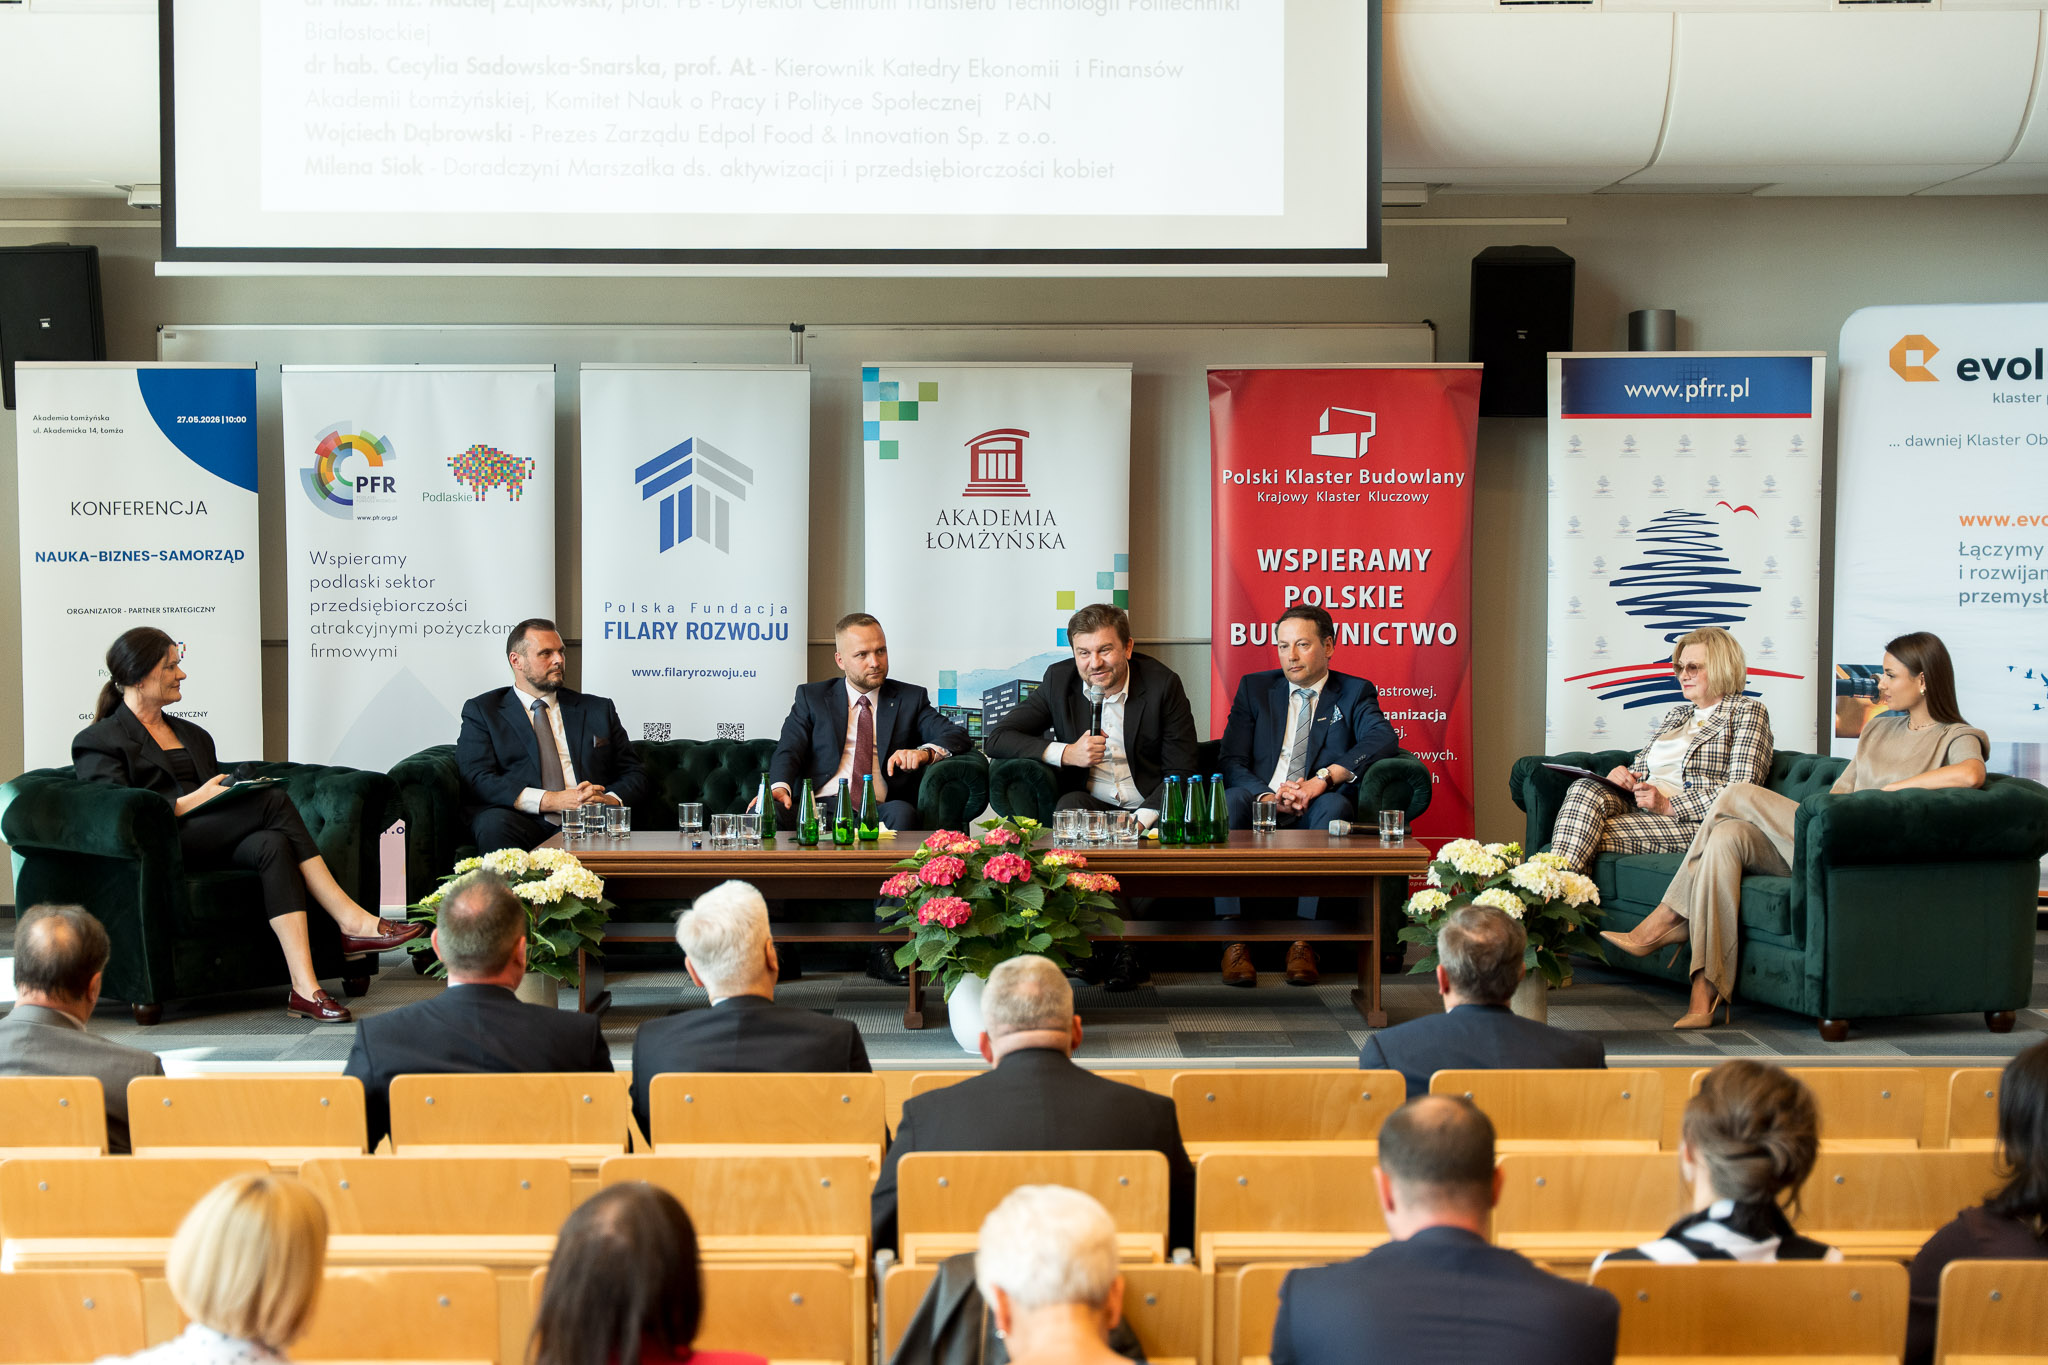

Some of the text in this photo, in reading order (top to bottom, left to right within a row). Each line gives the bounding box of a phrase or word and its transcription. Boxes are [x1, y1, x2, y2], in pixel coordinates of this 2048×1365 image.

[305, 20, 431, 47] Białostockiej
[304, 53, 327, 75] dr
[333, 53, 378, 75] hab.
[386, 54, 459, 80] Cecylia
[466, 53, 667, 79] Sadowska-Snarska,
[674, 55, 722, 81] prof.
[729, 56, 757, 76] AŁ
[775, 57, 875, 78] Kierownik
[883, 57, 961, 83] Katedry
[969, 58, 1059, 79] Ekonomii
[1075, 59, 1080, 79] i
[1088, 59, 1185, 79] Finansów
[304, 88, 1051, 117] Akademii Łomżyńskiej, Komitet Nauk o Pracy i Polityce Społecznej PAN
[304, 121, 396, 147] Wojciech
[404, 121, 512, 147] Dąbrowski
[532, 124, 597, 143] Prezes
[605, 123, 690, 147] Zarządu
[698, 123, 755, 149] Edpol
[764, 124, 814, 144] Food
[821, 125, 838, 144] &
[845, 125, 949, 144] Innovation
[957, 125, 989, 151] Sp.
[998, 132, 1010, 145] z
[1016, 132, 1056, 145] o.o.
[304, 155, 372, 176] Milena
[381, 155, 424, 176] Siok
[444, 156, 560, 182] Doradczyni
[568, 156, 675, 177] Marszałka
[683, 156, 711, 177] ds.
[720, 158, 834, 184] aktywizacji
[843, 159, 847, 177] i
[856, 157, 1047, 184] przedsiębiorczości
[1053, 158, 1115, 179] kobiet
[1956, 348, 2048, 381] evol
[1624, 377, 1749, 402] www.pfrr.pl
[1993, 392, 2042, 403] klaster
[177, 415, 220, 423] 27.05.2026
[226, 415, 246, 423] 10:00
[1906, 434, 1961, 449] dawniej
[1968, 434, 2020, 446] Klaster
[357, 476, 396, 493] PFR
[1222, 469, 1465, 488] Polski Klaster Budowlany
[422, 490, 472, 503] Podlaskie
[1258, 491, 1429, 504] Krajowy Klaster Kluczowy
[71, 501, 207, 515] KONFERENCJA
[936, 509, 1056, 526] AKADEMIA
[926, 529, 1065, 549] ŁOMŻYŃSKA
[36, 550, 244, 563] NAUKA-BIZNES-SAMORZĄD
[310, 551, 406, 568] Wspieramy
[1959, 541, 2044, 560] Łączymy
[1257, 549, 1432, 572] WSPIERAMY
[1959, 565, 1963, 580] i
[310, 573, 435, 592] podlaski sektor
[311, 597, 466, 615] przedsiębiorczości
[1285, 586, 1404, 608] POLSKIE
[605, 602, 787, 616] Polska Fundacja
[311, 619, 516, 638] atrakcyjnymi pożyczkam
[605, 622, 788, 640] FILARY ROZWOJU
[1231, 623, 1457, 645] BUNICTWO
[310, 643, 397, 660] firmowymi
[632, 667, 756, 679] www.filaryrozwoju.eu
